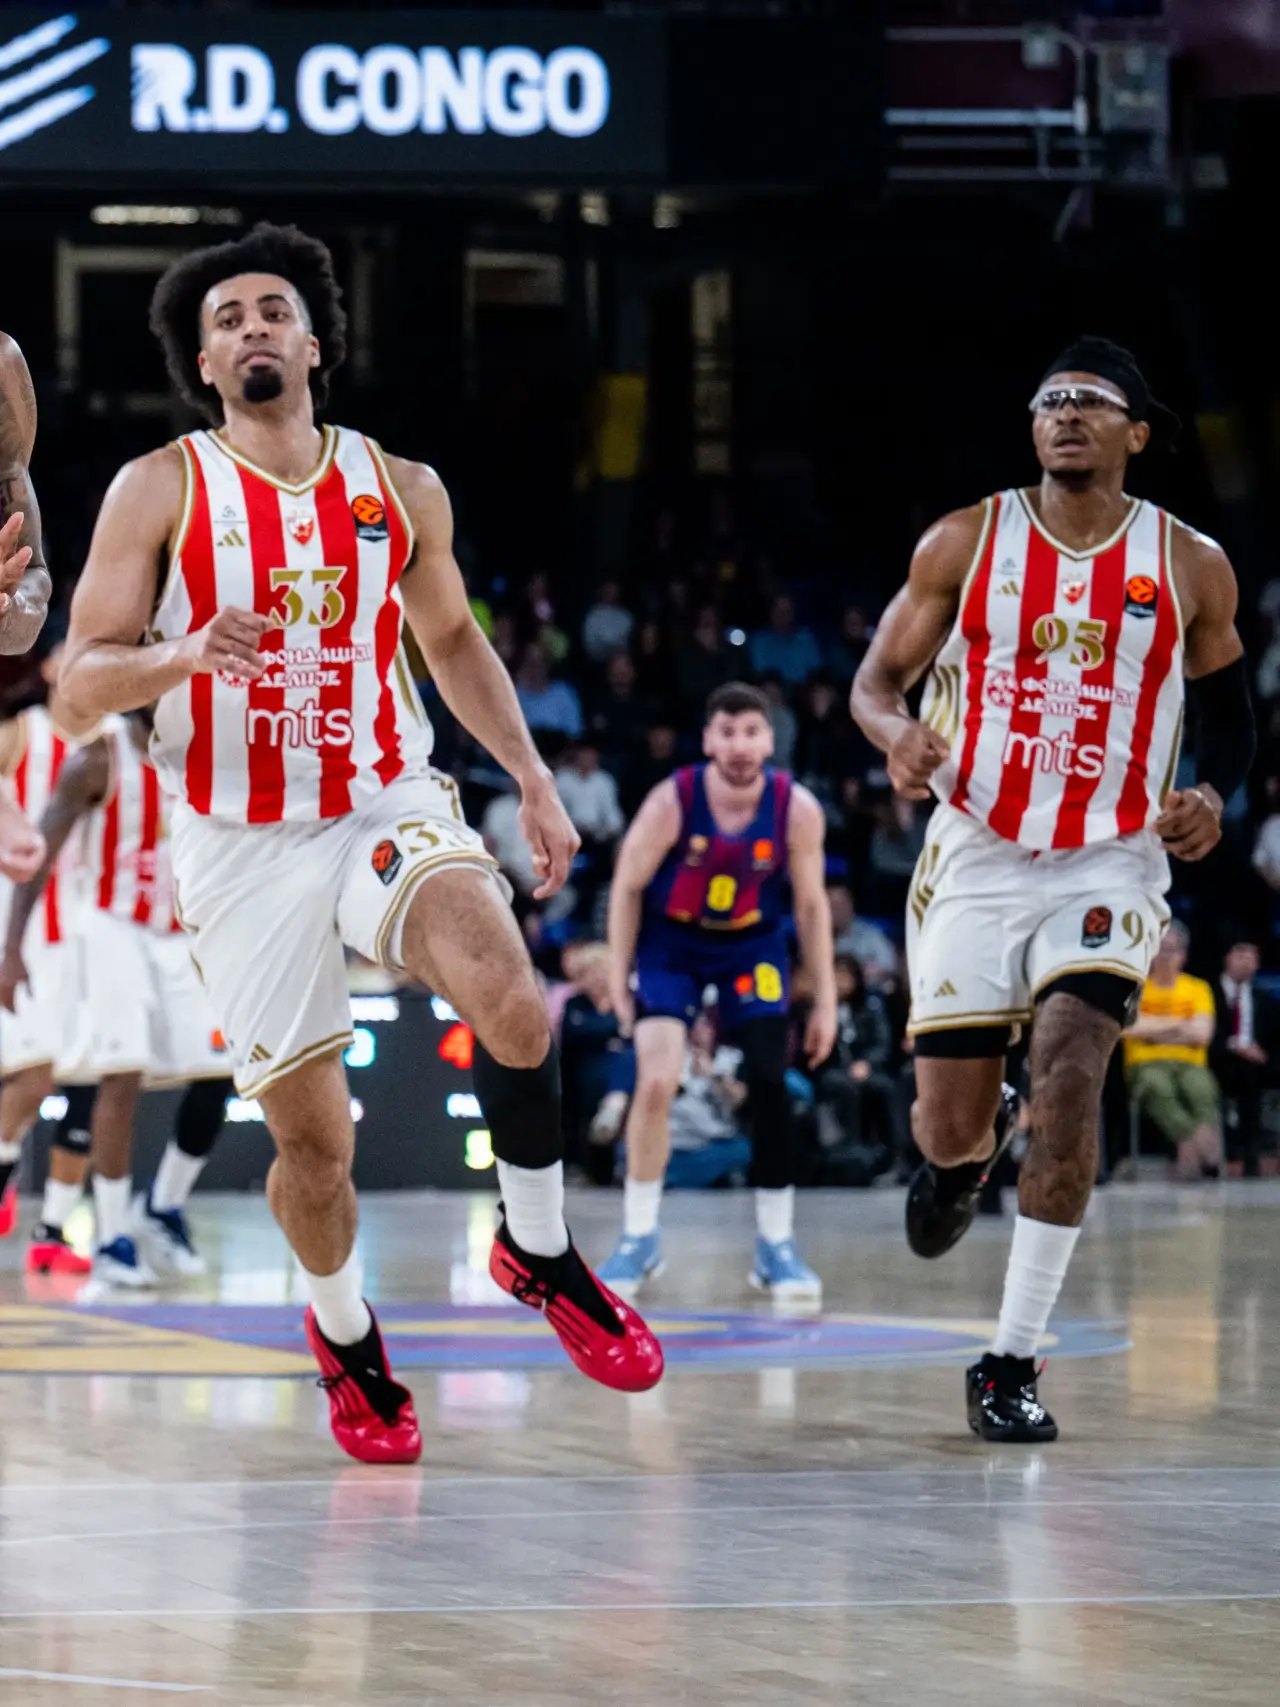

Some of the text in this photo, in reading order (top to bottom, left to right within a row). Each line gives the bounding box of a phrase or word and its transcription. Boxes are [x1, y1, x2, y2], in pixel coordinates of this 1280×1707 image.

[131, 43, 610, 137] R.D. CONGO
[269, 566, 347, 629] 33
[1032, 613, 1107, 671] 95
[246, 698, 354, 749] mts
[1003, 730, 1106, 779] mts
[1122, 908, 1145, 951] 9
